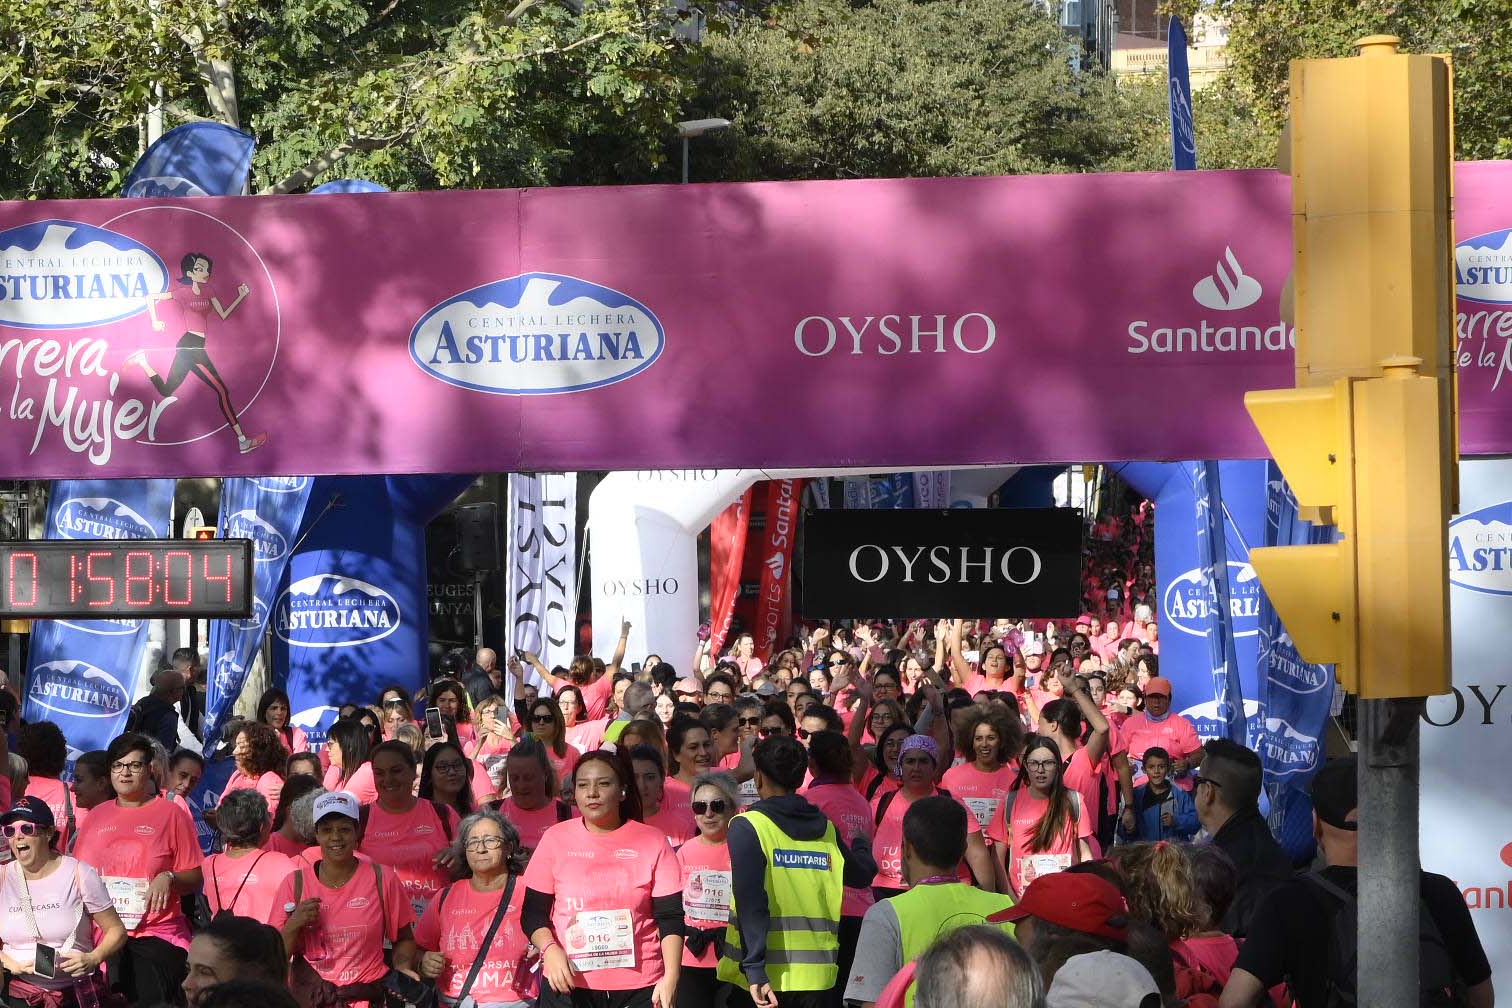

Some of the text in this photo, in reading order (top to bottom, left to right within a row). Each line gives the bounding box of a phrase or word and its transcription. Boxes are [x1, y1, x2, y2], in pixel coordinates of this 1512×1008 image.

[72, 255, 144, 268] LECHERA
[468, 313, 637, 328] CENTRAL LECHERA
[428, 320, 645, 364] ASTURIANA
[794, 312, 997, 357] OYSHO
[1477, 339, 1496, 367] la
[10, 380, 34, 420] la
[29, 373, 178, 466] Mujer
[849, 544, 1042, 585] OYSHO
[603, 577, 679, 596] OYSHO
[291, 599, 386, 608] CENTRAL LECHERA
[279, 604, 392, 631] ASTURIANA
[29, 672, 121, 710] ASTURIANA
[883, 846, 898, 856] TU
[704, 888, 723, 897] 016
[8, 902, 61, 913] CUAECASAS
[567, 897, 584, 911] TU
[588, 933, 611, 942] 016
